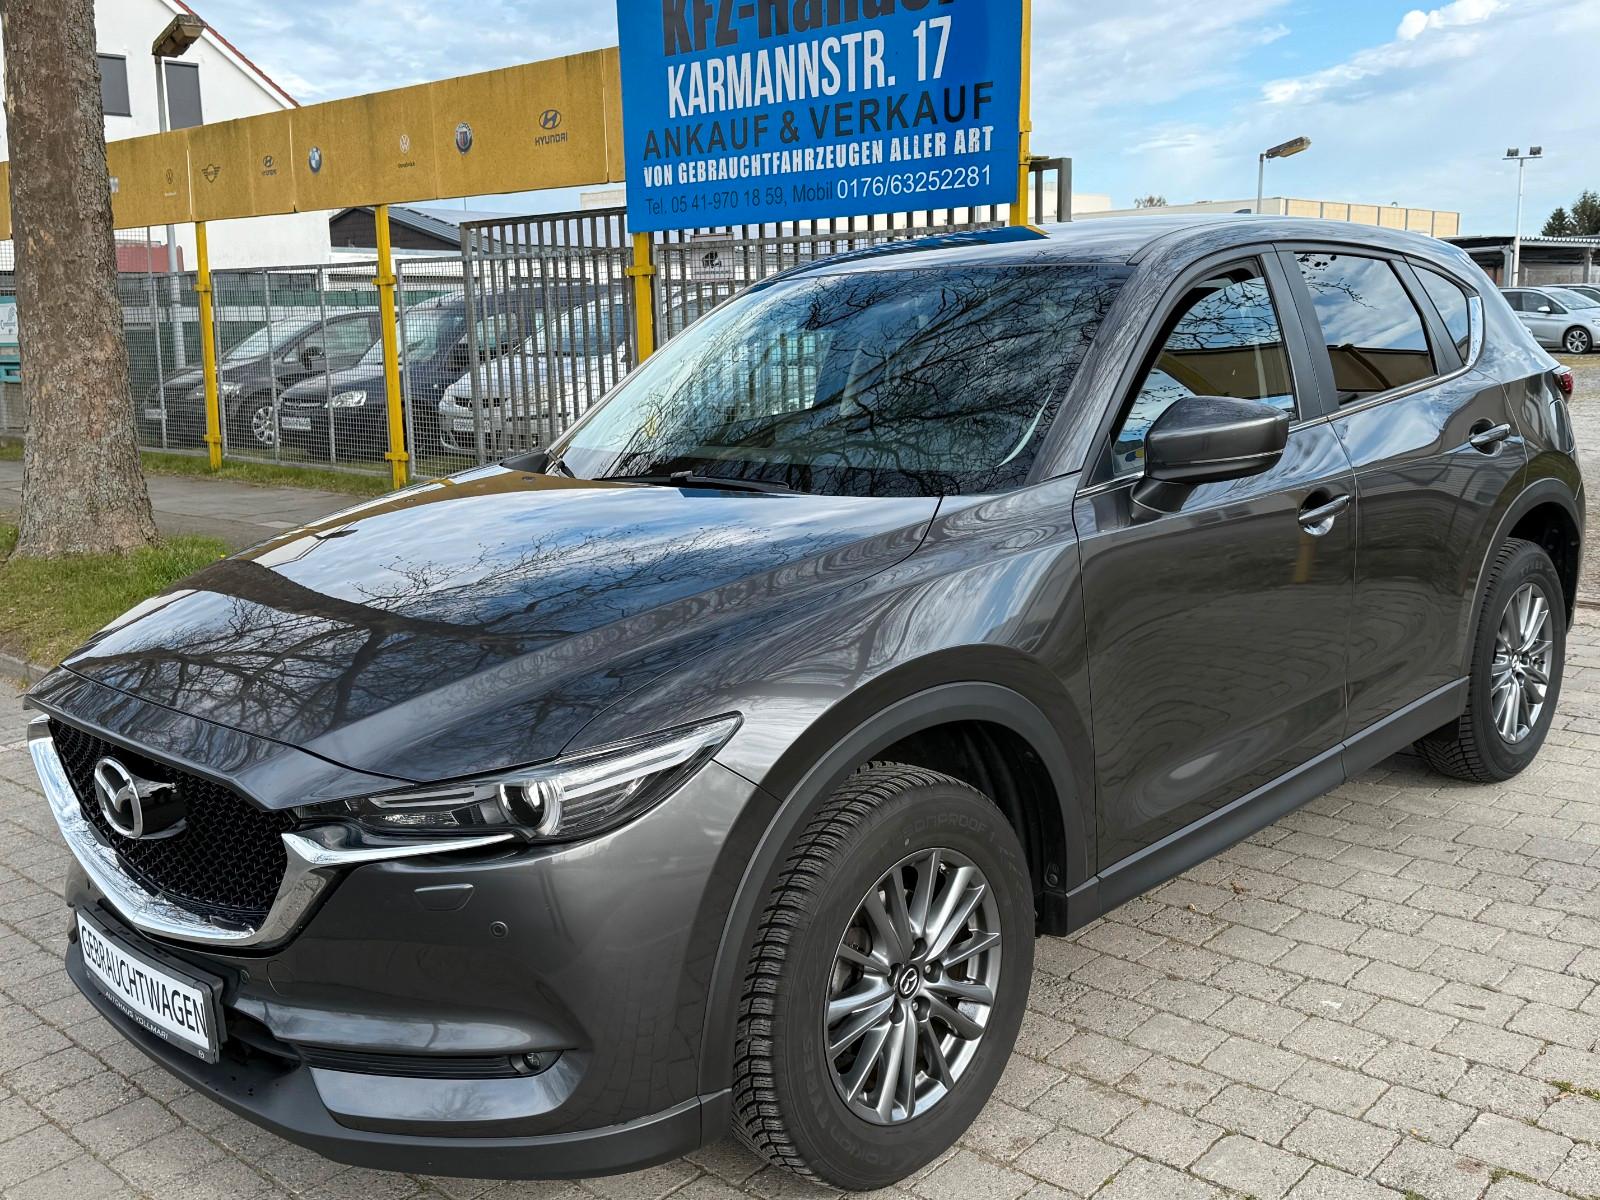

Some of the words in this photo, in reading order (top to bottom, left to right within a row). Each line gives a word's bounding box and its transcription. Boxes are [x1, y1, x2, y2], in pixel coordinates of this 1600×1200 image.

[667, 29, 896, 118] KARMANNSTR.
[913, 16, 952, 81] 17
[534, 132, 568, 147] HYUNDAI
[643, 113, 769, 161] ANKAUF
[780, 110, 800, 143] &
[810, 81, 993, 140] VERKAUF
[643, 164, 673, 188] VON
[678, 140, 883, 184] GEBRAUCHTFAHRZEUGEN
[890, 131, 947, 162] ALLER
[954, 125, 994, 155] ART
[645, 198, 668, 215] Tel.
[671, 196, 688, 213] 05
[691, 191, 738, 211] 41-970
[744, 188, 760, 207] 18
[765, 186, 787, 208] 59,
[793, 181, 833, 204] Mobil
[837, 164, 990, 199] 0176/63252281
[81, 925, 208, 1038] GEBRAUCHTWAGEN
[105, 991, 134, 1018] AUTOHAUS
